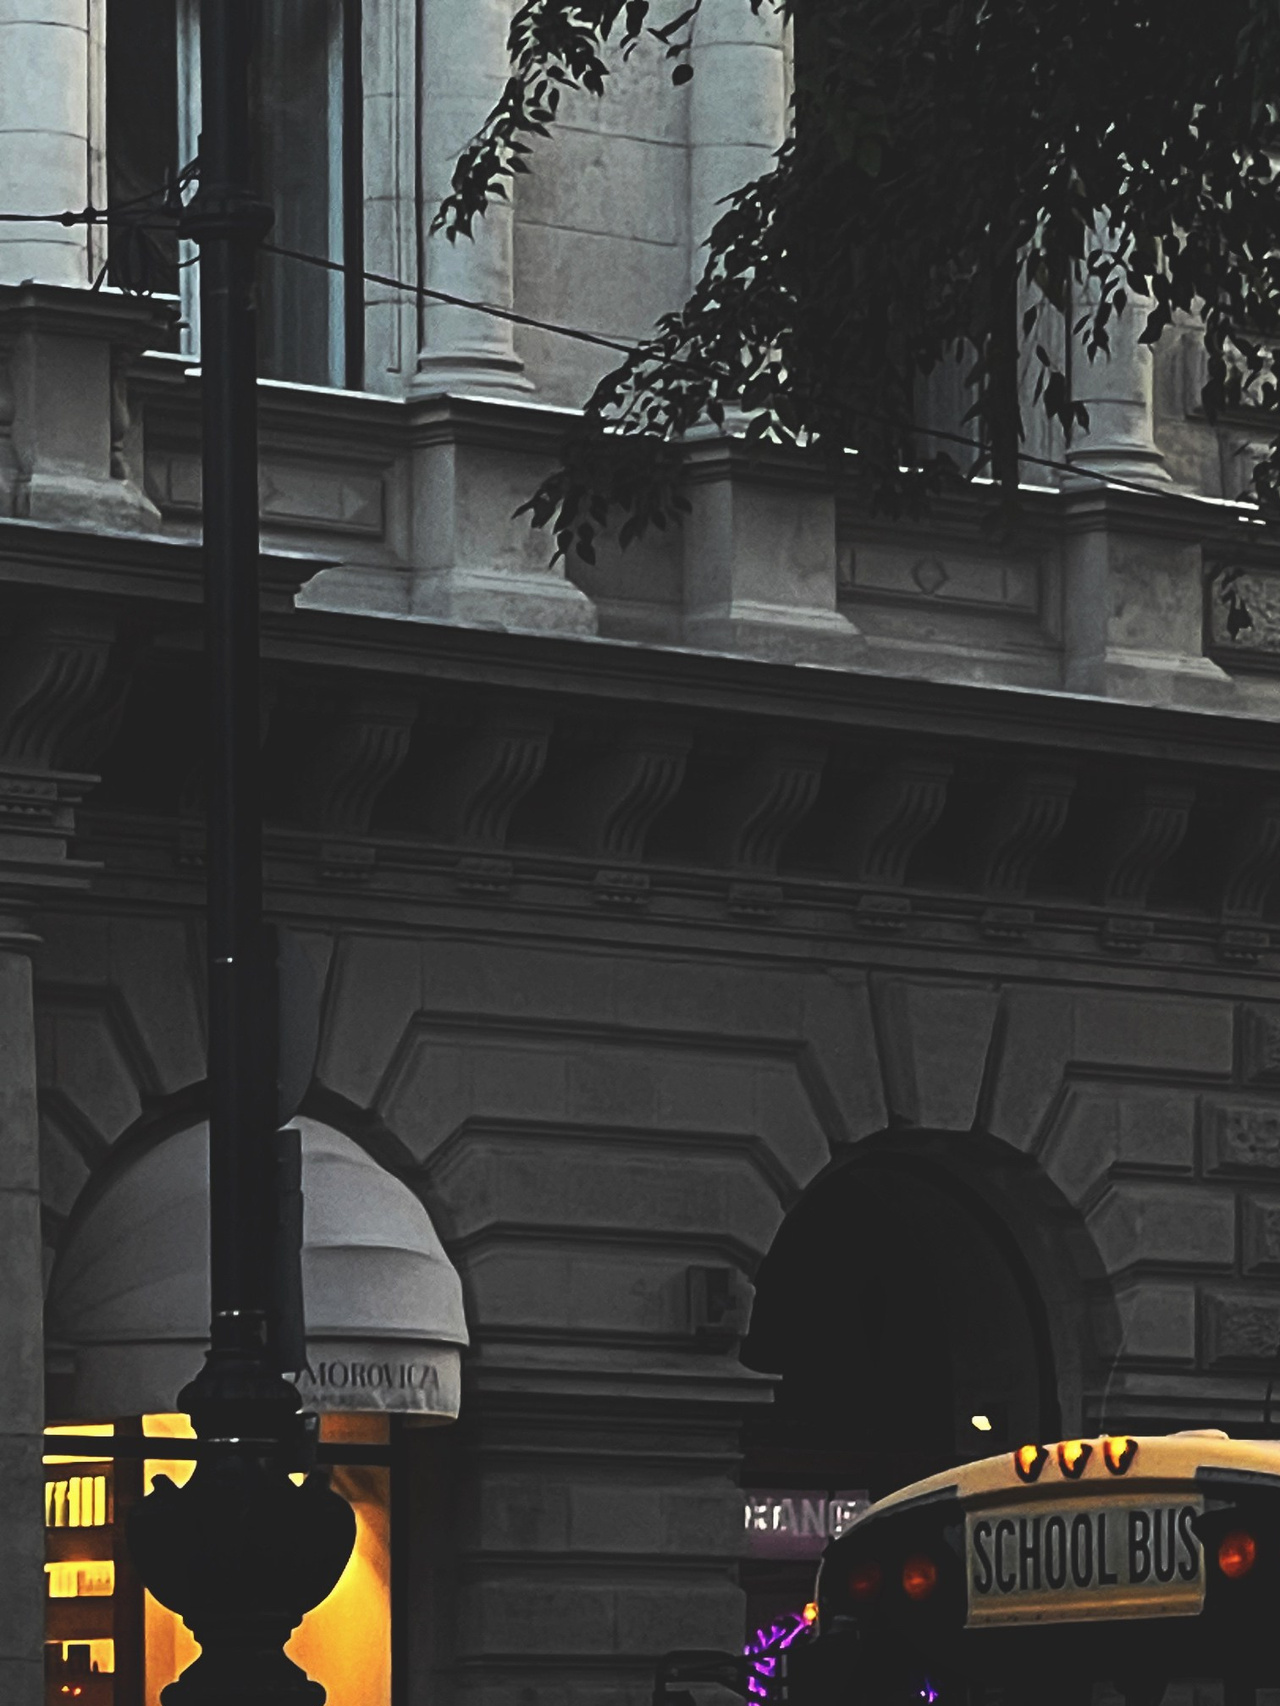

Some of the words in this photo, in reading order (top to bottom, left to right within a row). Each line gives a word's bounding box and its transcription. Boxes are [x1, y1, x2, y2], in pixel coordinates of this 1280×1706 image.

[292, 1361, 440, 1391] MOROVICZA
[973, 1512, 1118, 1595] SCHOOL
[1128, 1505, 1199, 1581] BUS
